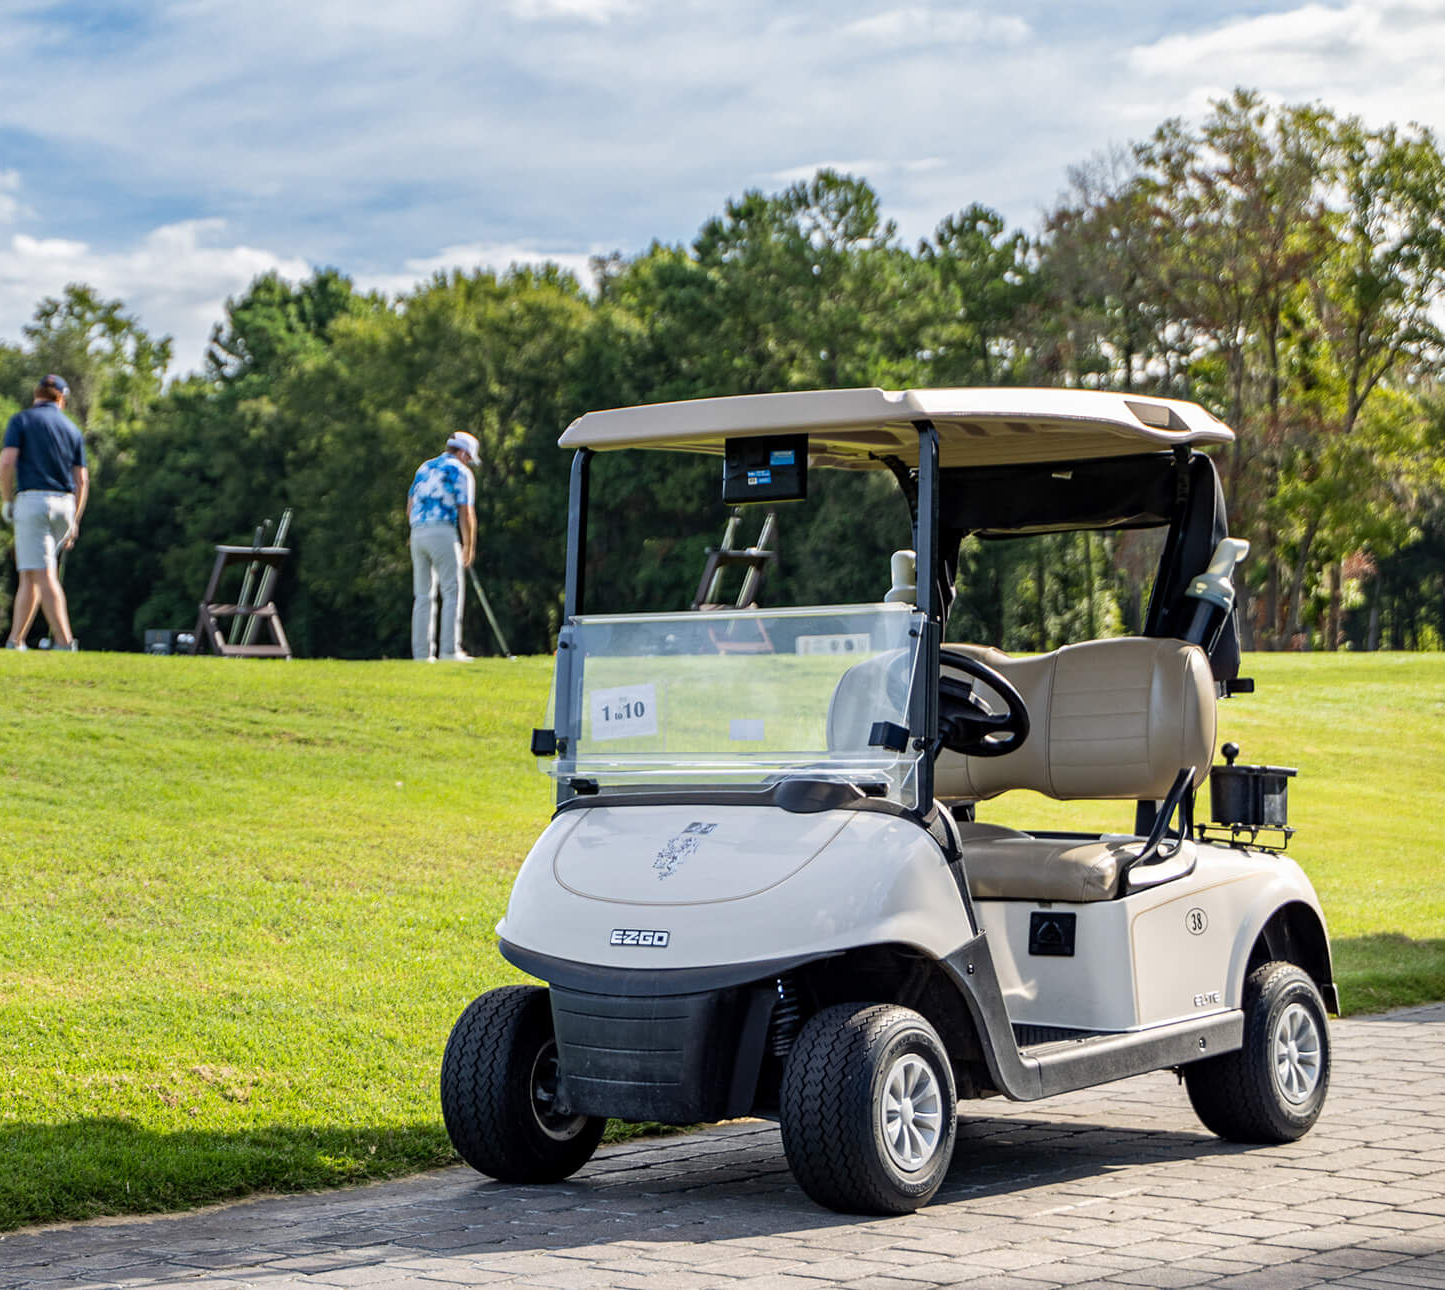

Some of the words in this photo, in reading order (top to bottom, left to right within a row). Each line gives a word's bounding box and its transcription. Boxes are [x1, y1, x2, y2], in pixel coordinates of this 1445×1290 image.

[602, 705, 609, 721] 1
[623, 701, 645, 719] 10
[1191, 912, 1203, 931] 38
